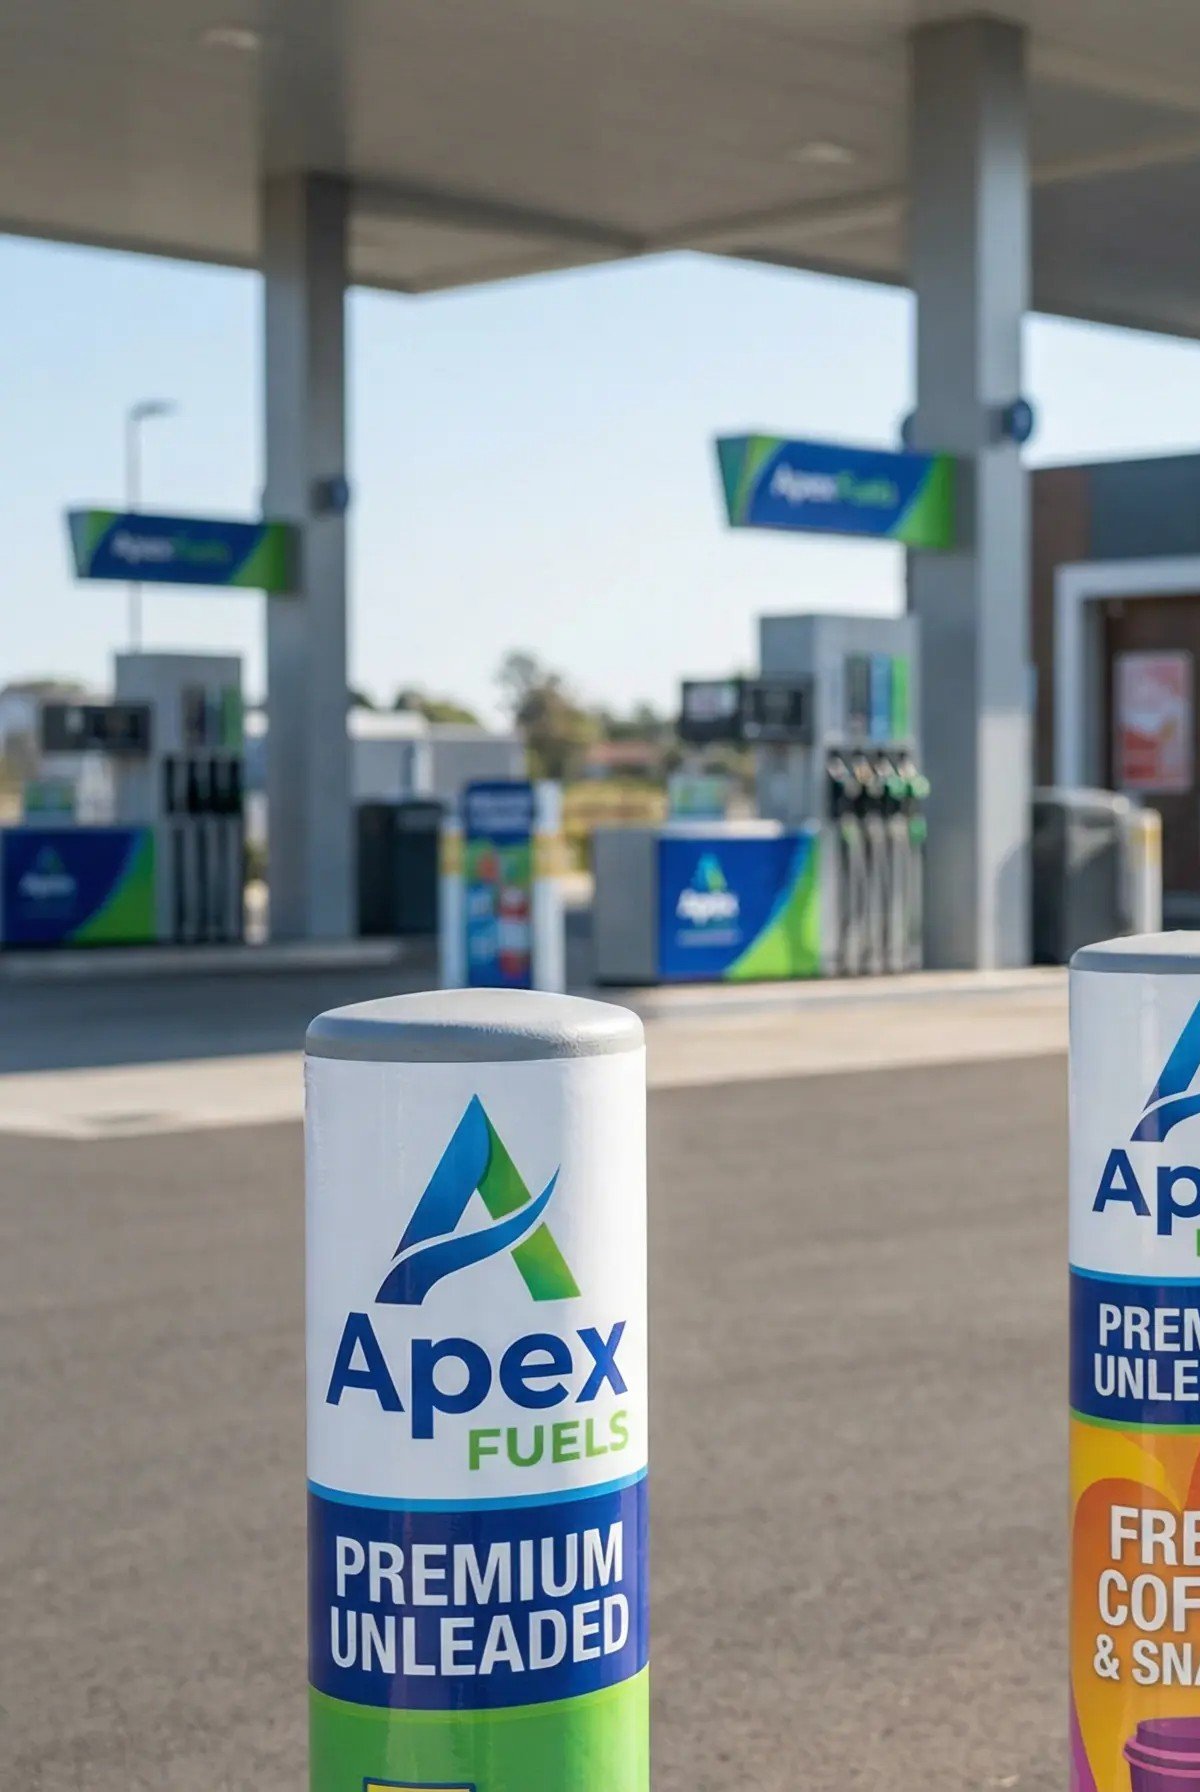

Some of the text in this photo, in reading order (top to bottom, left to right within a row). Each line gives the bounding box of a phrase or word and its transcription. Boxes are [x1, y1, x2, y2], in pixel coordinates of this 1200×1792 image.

[326, 1312, 628, 1439] Apex
[469, 1410, 629, 1470] FUELS
[336, 1521, 623, 1606] PREMIUM
[330, 1593, 629, 1676] UNLEADED
[1094, 1634, 1120, 1681] &
